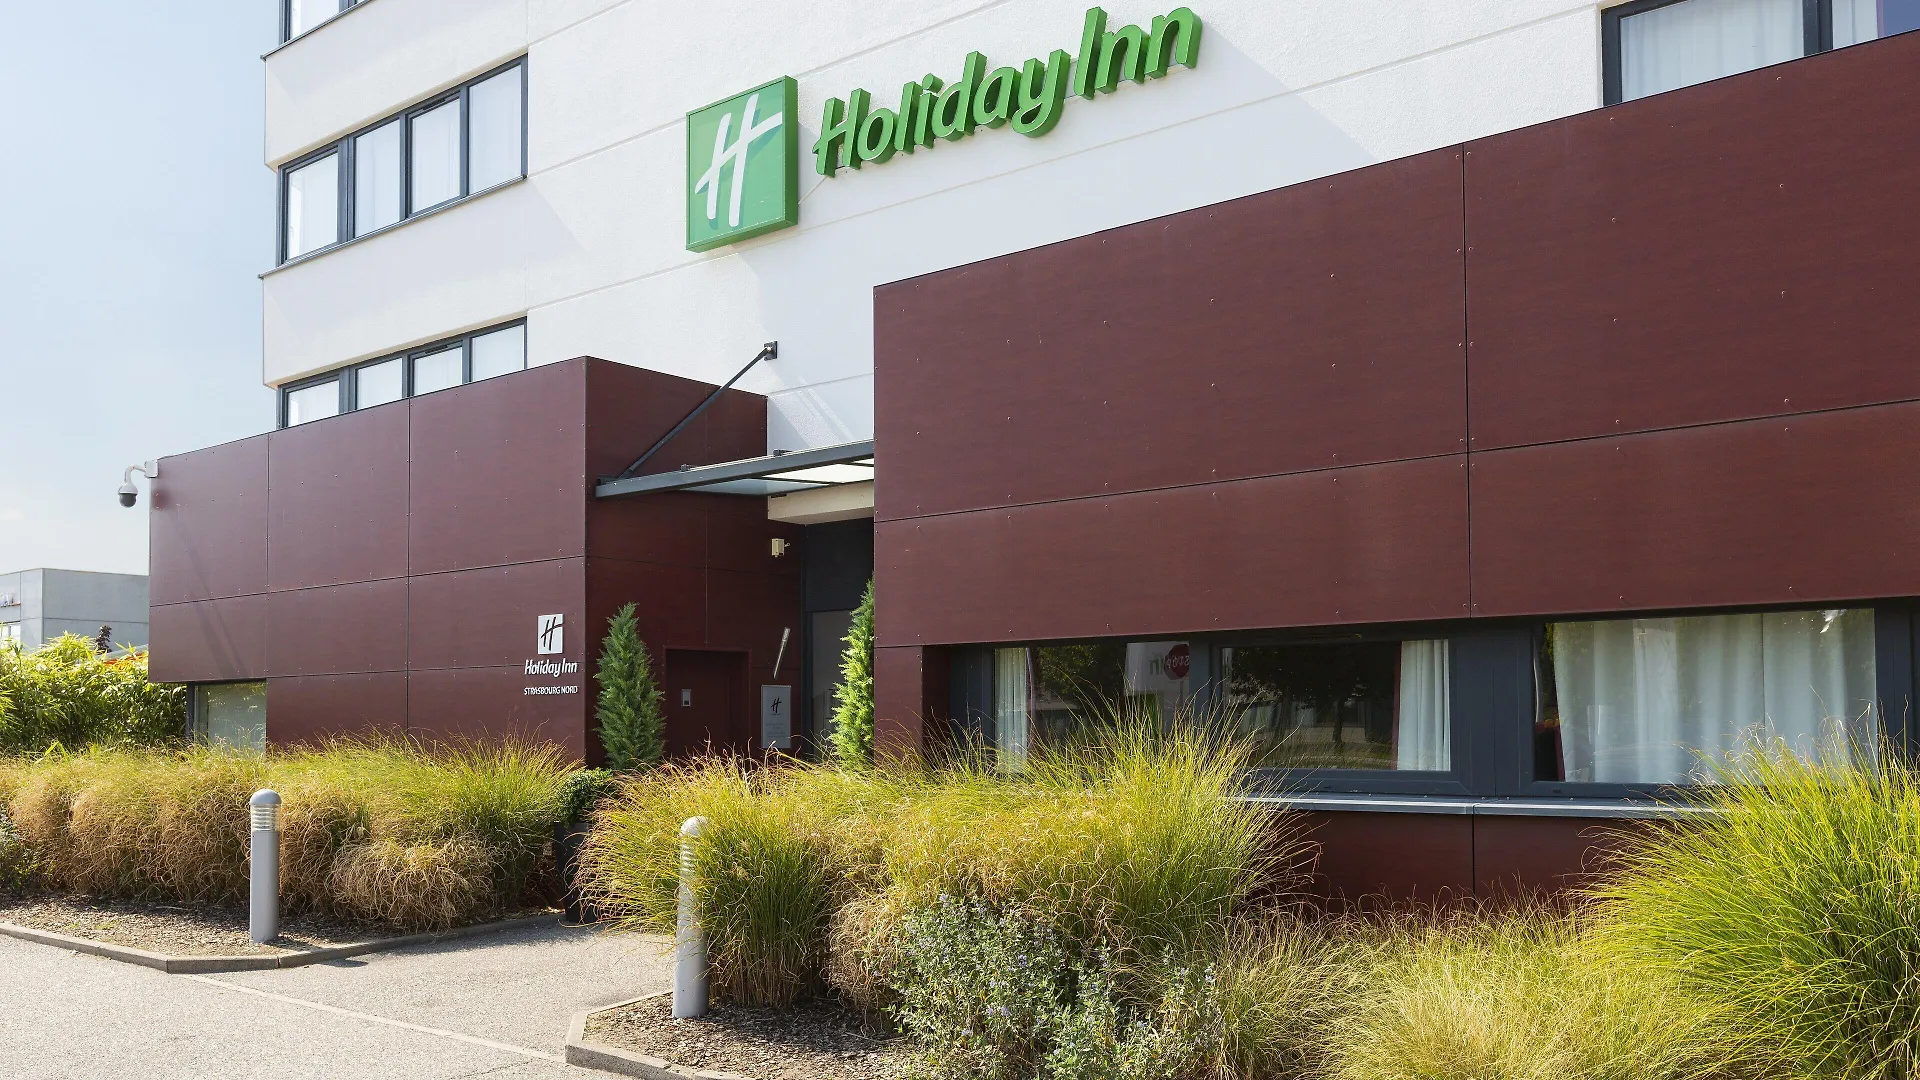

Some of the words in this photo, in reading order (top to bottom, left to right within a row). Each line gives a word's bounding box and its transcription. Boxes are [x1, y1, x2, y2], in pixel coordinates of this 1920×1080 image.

[812, 48, 1072, 178] Holiday
[1073, 6, 1203, 101] Inn
[694, 93, 783, 227] H
[524, 659, 561, 678] Holiday
[562, 658, 578, 674] Inn
[524, 686, 560, 696] STRASBOURG
[561, 686, 578, 694] NORD
